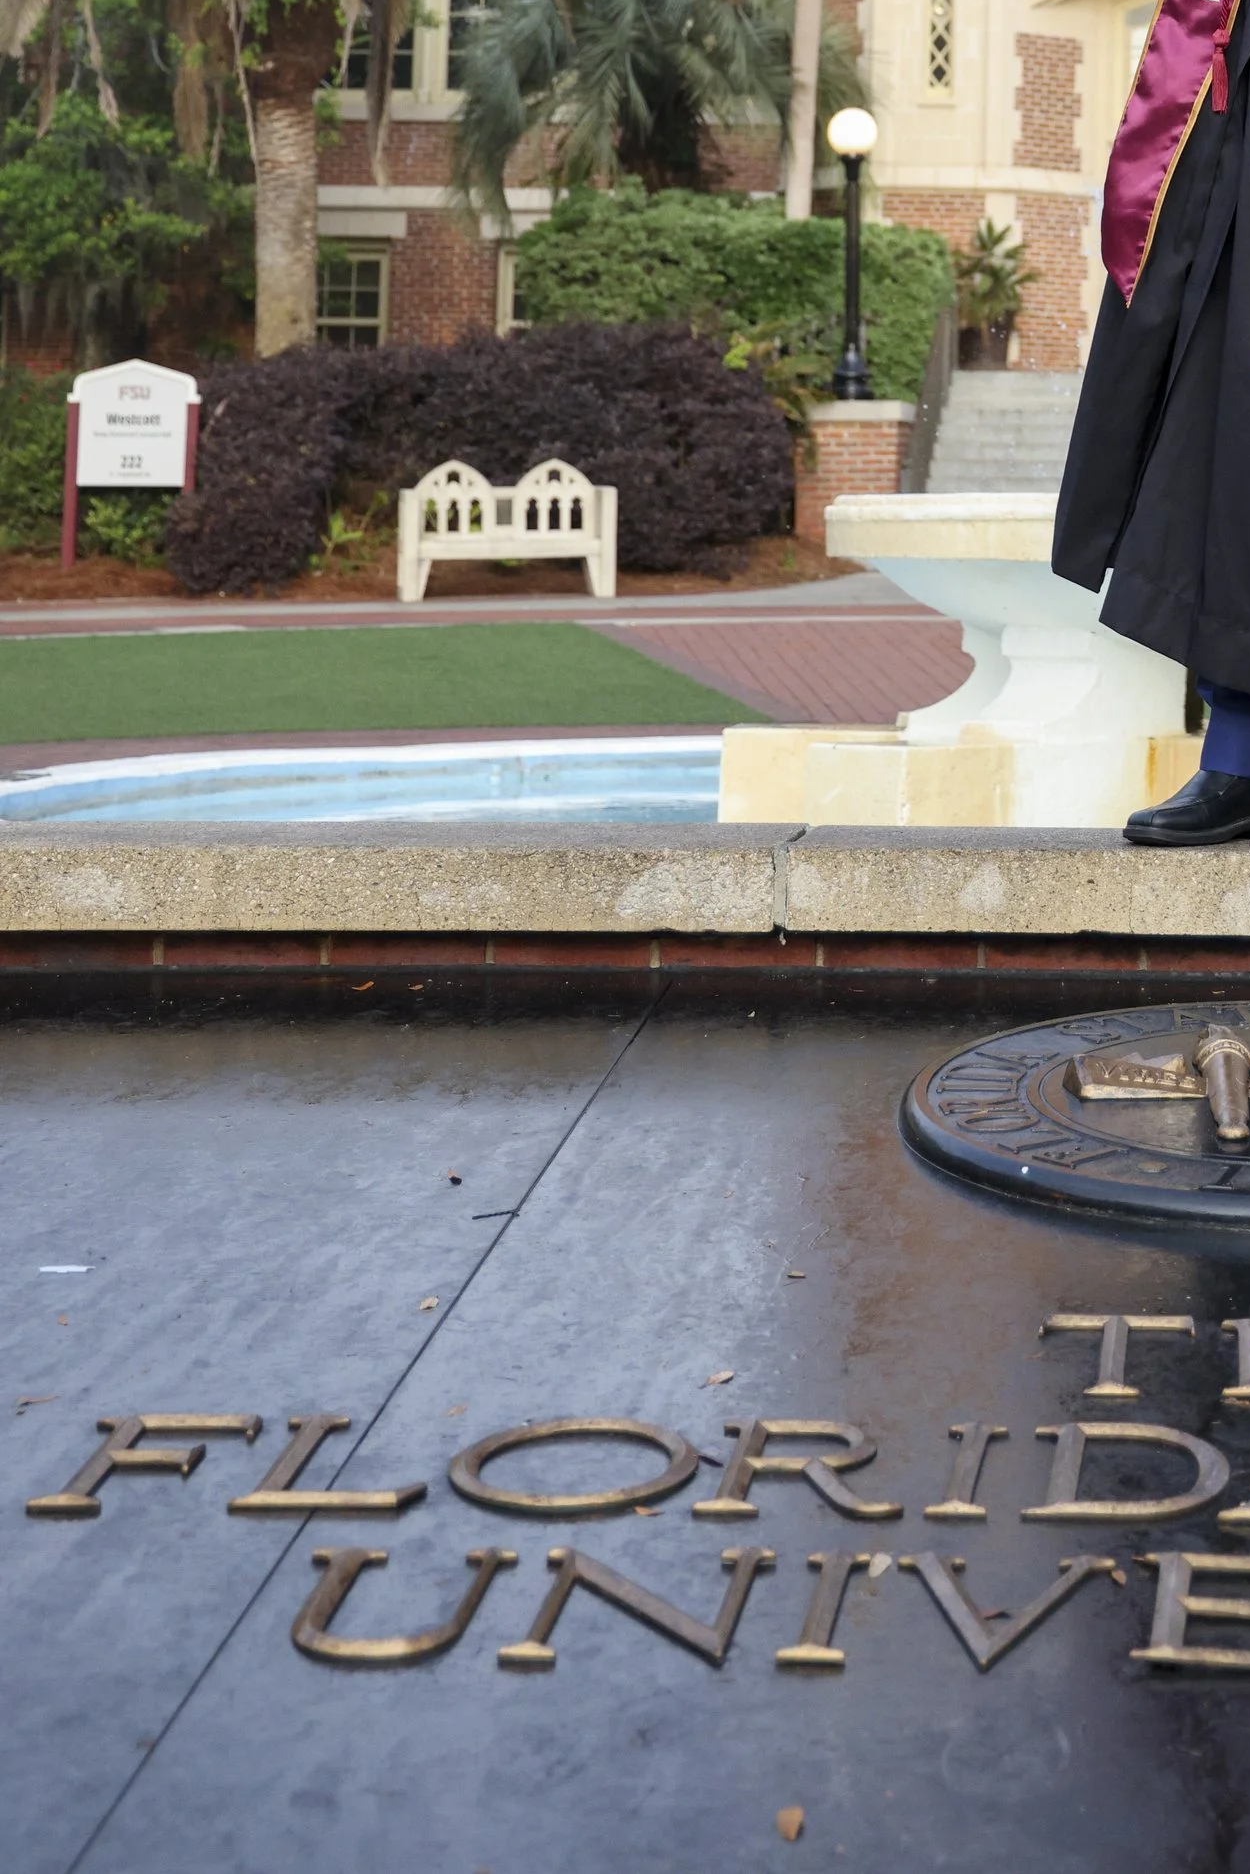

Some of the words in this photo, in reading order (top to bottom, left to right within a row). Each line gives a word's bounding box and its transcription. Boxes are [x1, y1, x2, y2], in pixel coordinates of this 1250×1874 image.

[118, 385, 151, 400] FSU
[106, 413, 161, 426] Westcott
[121, 455, 143, 469] 222
